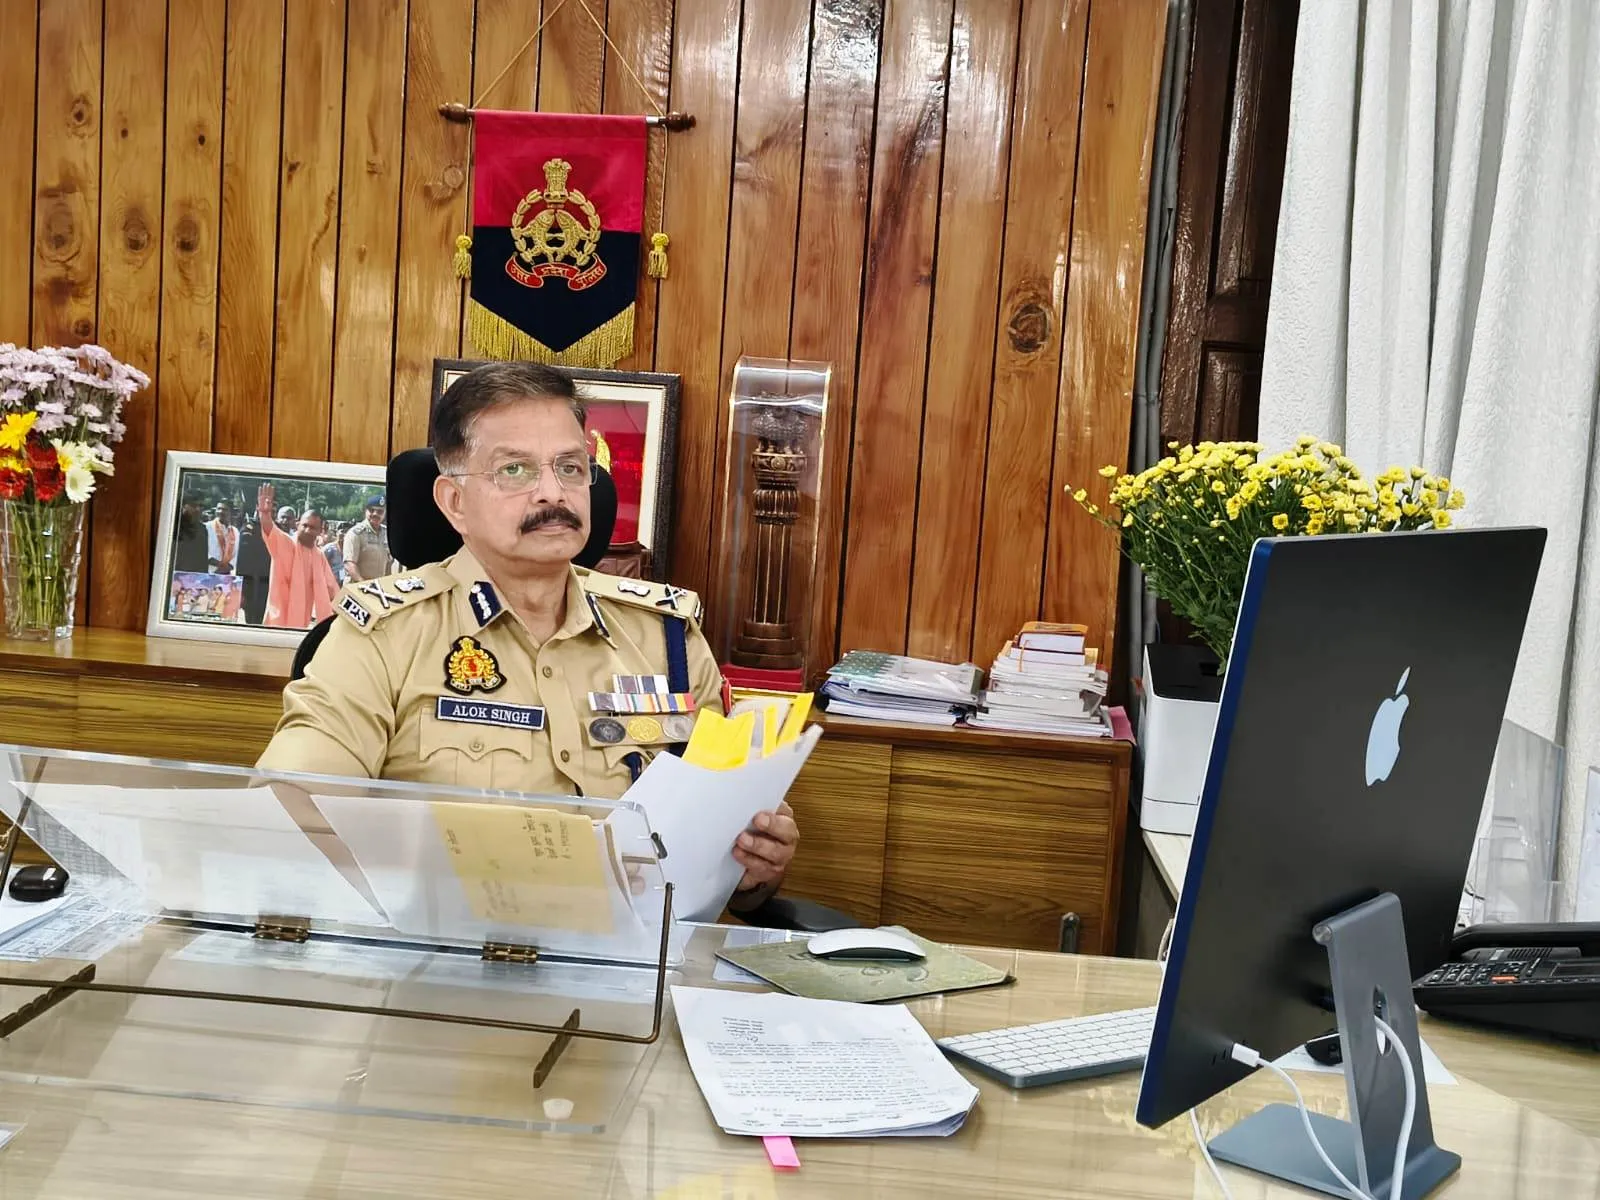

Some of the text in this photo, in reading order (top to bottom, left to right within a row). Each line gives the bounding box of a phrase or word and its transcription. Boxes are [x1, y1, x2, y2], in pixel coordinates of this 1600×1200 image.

[339, 595, 370, 626] IPS
[452, 704, 531, 724] ALOK SINGH
